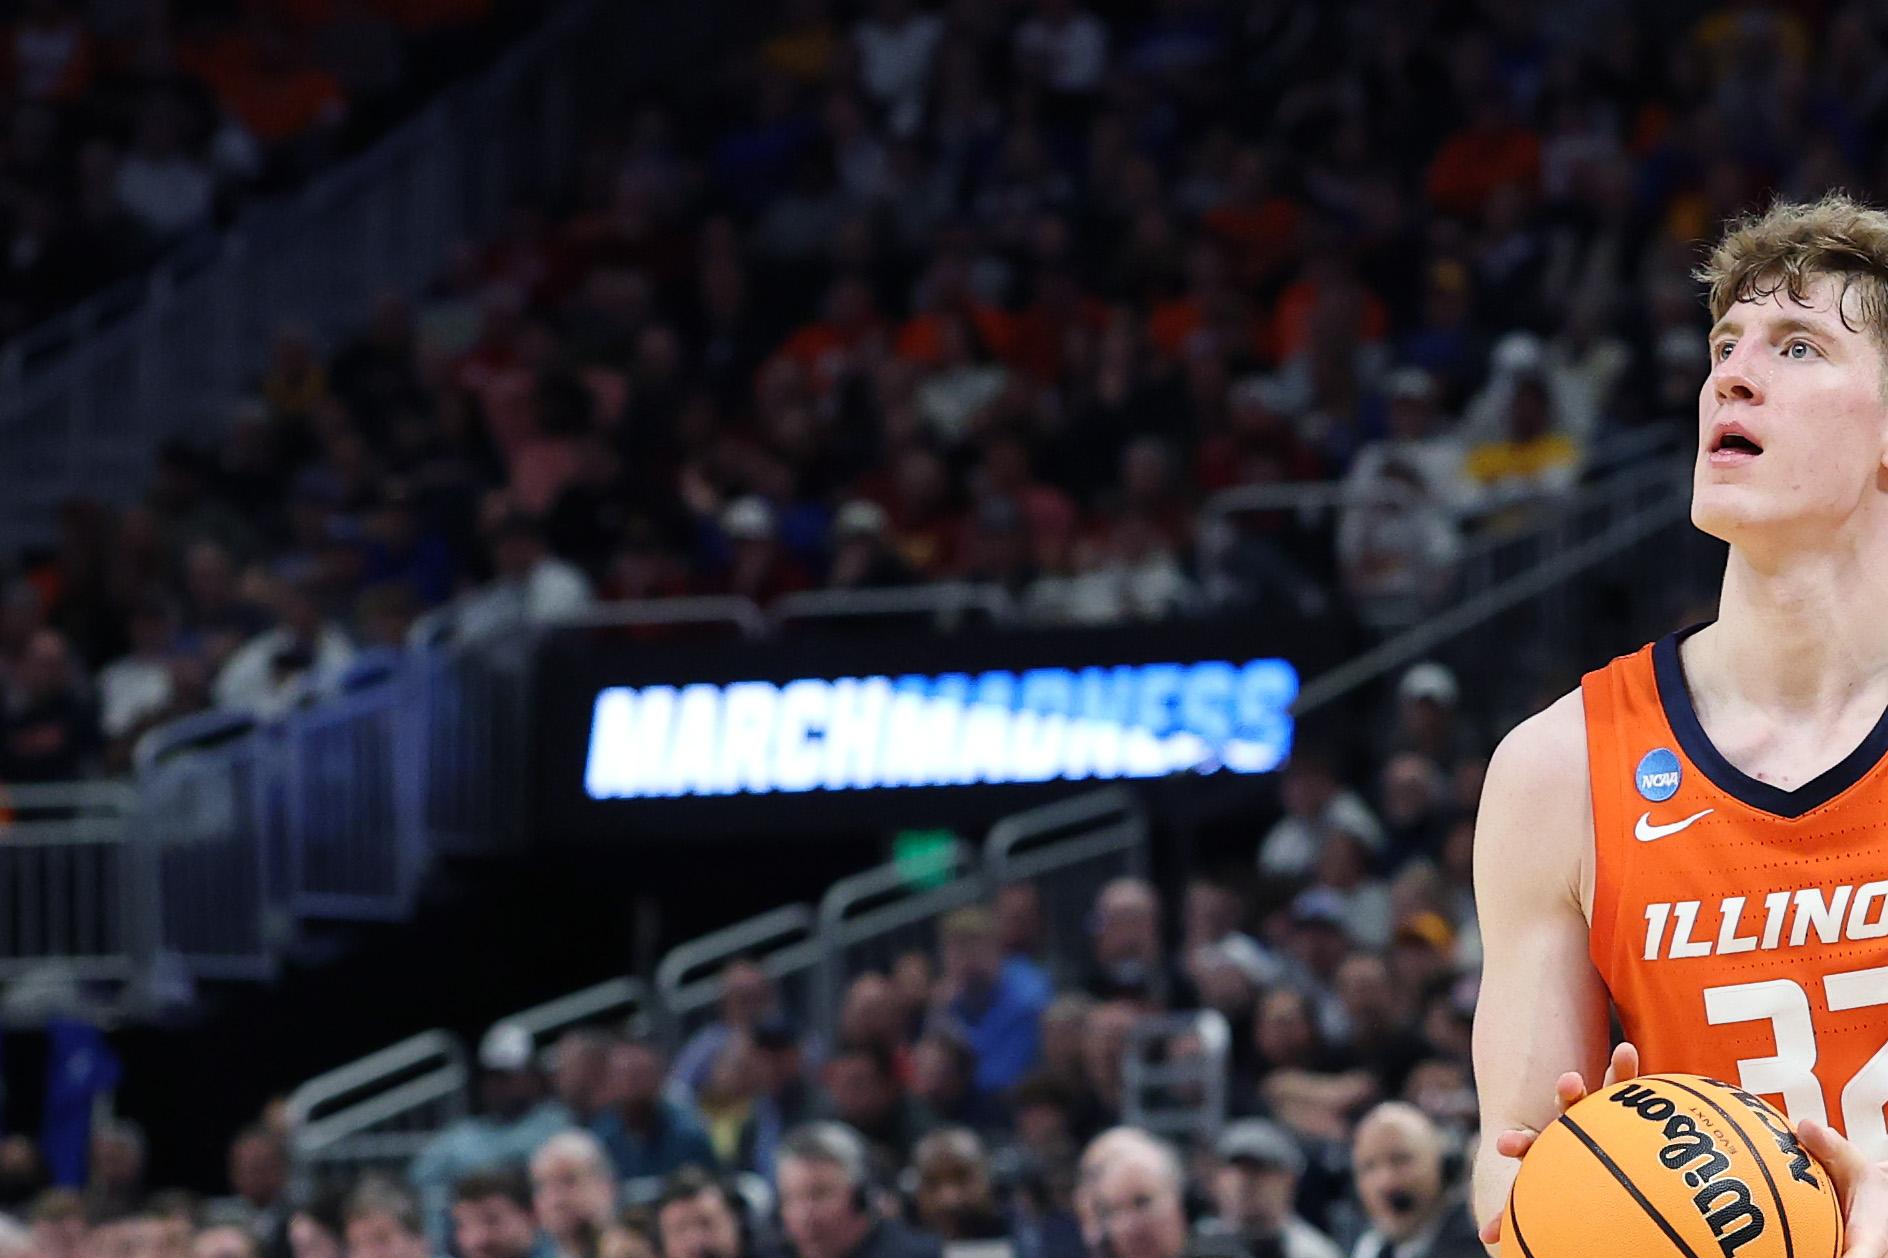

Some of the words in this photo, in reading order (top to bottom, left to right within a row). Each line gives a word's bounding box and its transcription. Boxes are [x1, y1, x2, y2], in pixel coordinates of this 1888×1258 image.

[1641, 771, 1680, 789] NCAA
[1688, 1106, 1713, 1128] NXT
[1713, 1129, 1738, 1156] EVO
